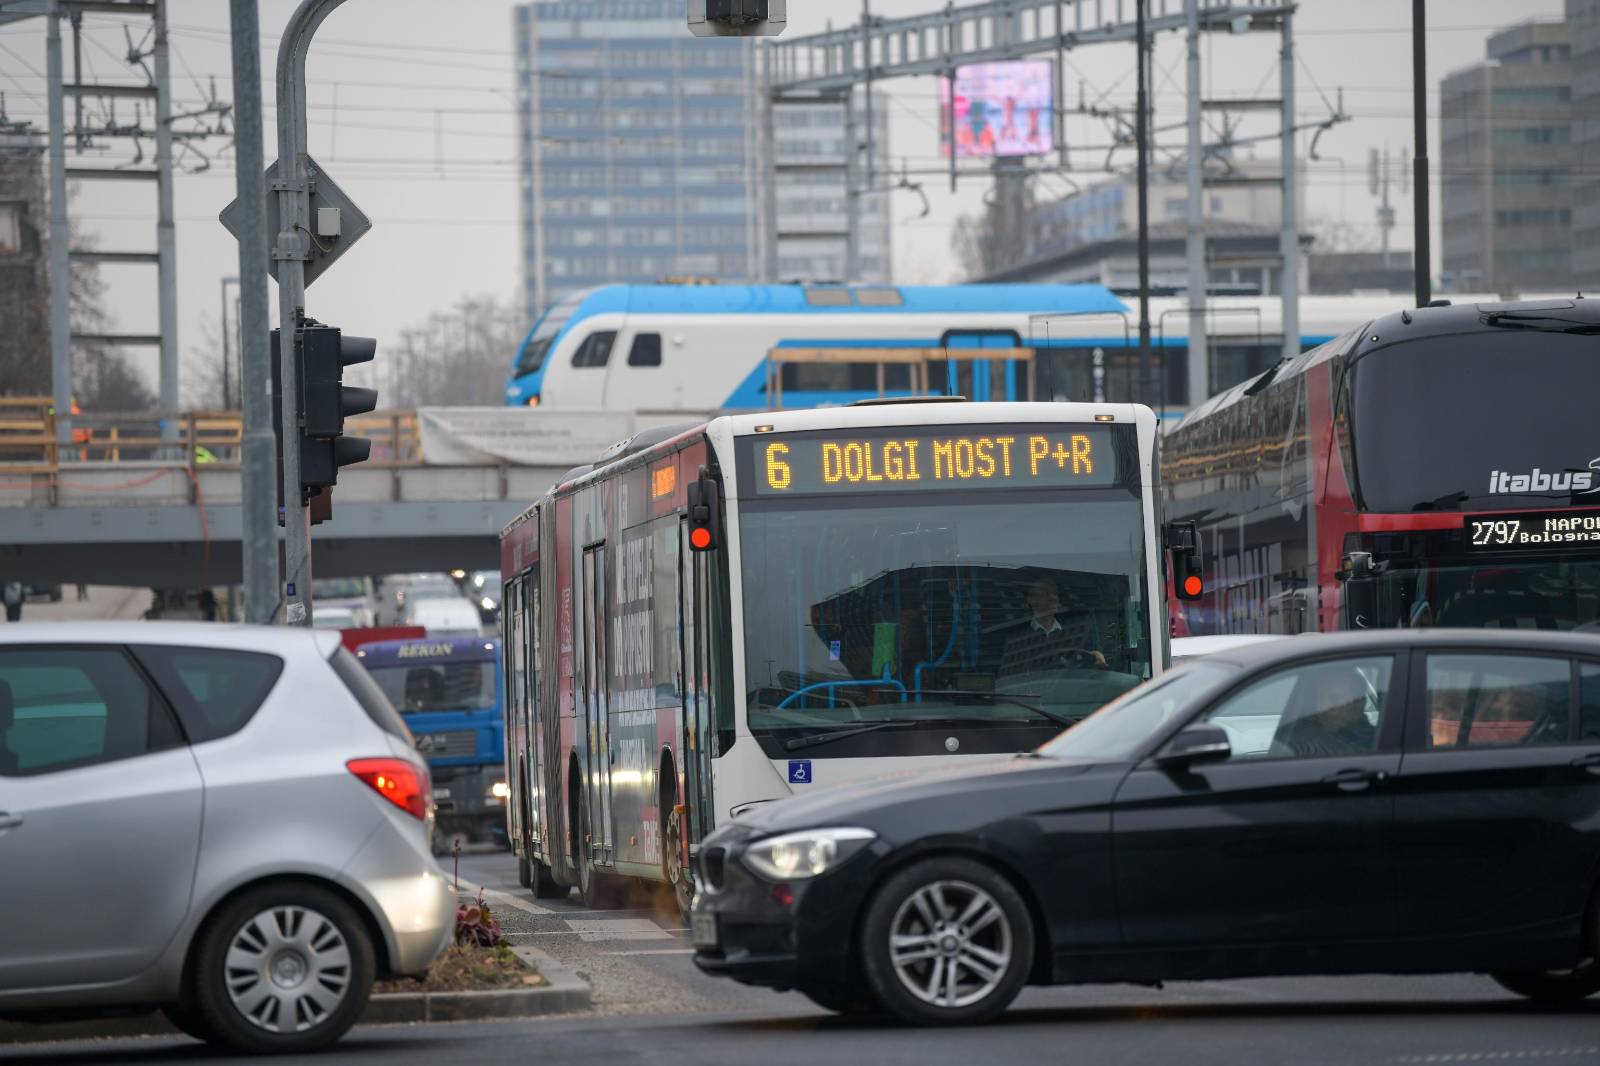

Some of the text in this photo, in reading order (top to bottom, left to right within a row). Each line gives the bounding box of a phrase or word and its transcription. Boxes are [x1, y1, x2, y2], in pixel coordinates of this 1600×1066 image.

[766, 434, 1093, 489] 6 DOLGI MOST P+R
[1489, 468, 1593, 494] itabus
[1472, 521, 1520, 545] 2797
[1520, 531, 1600, 544] Bologna
